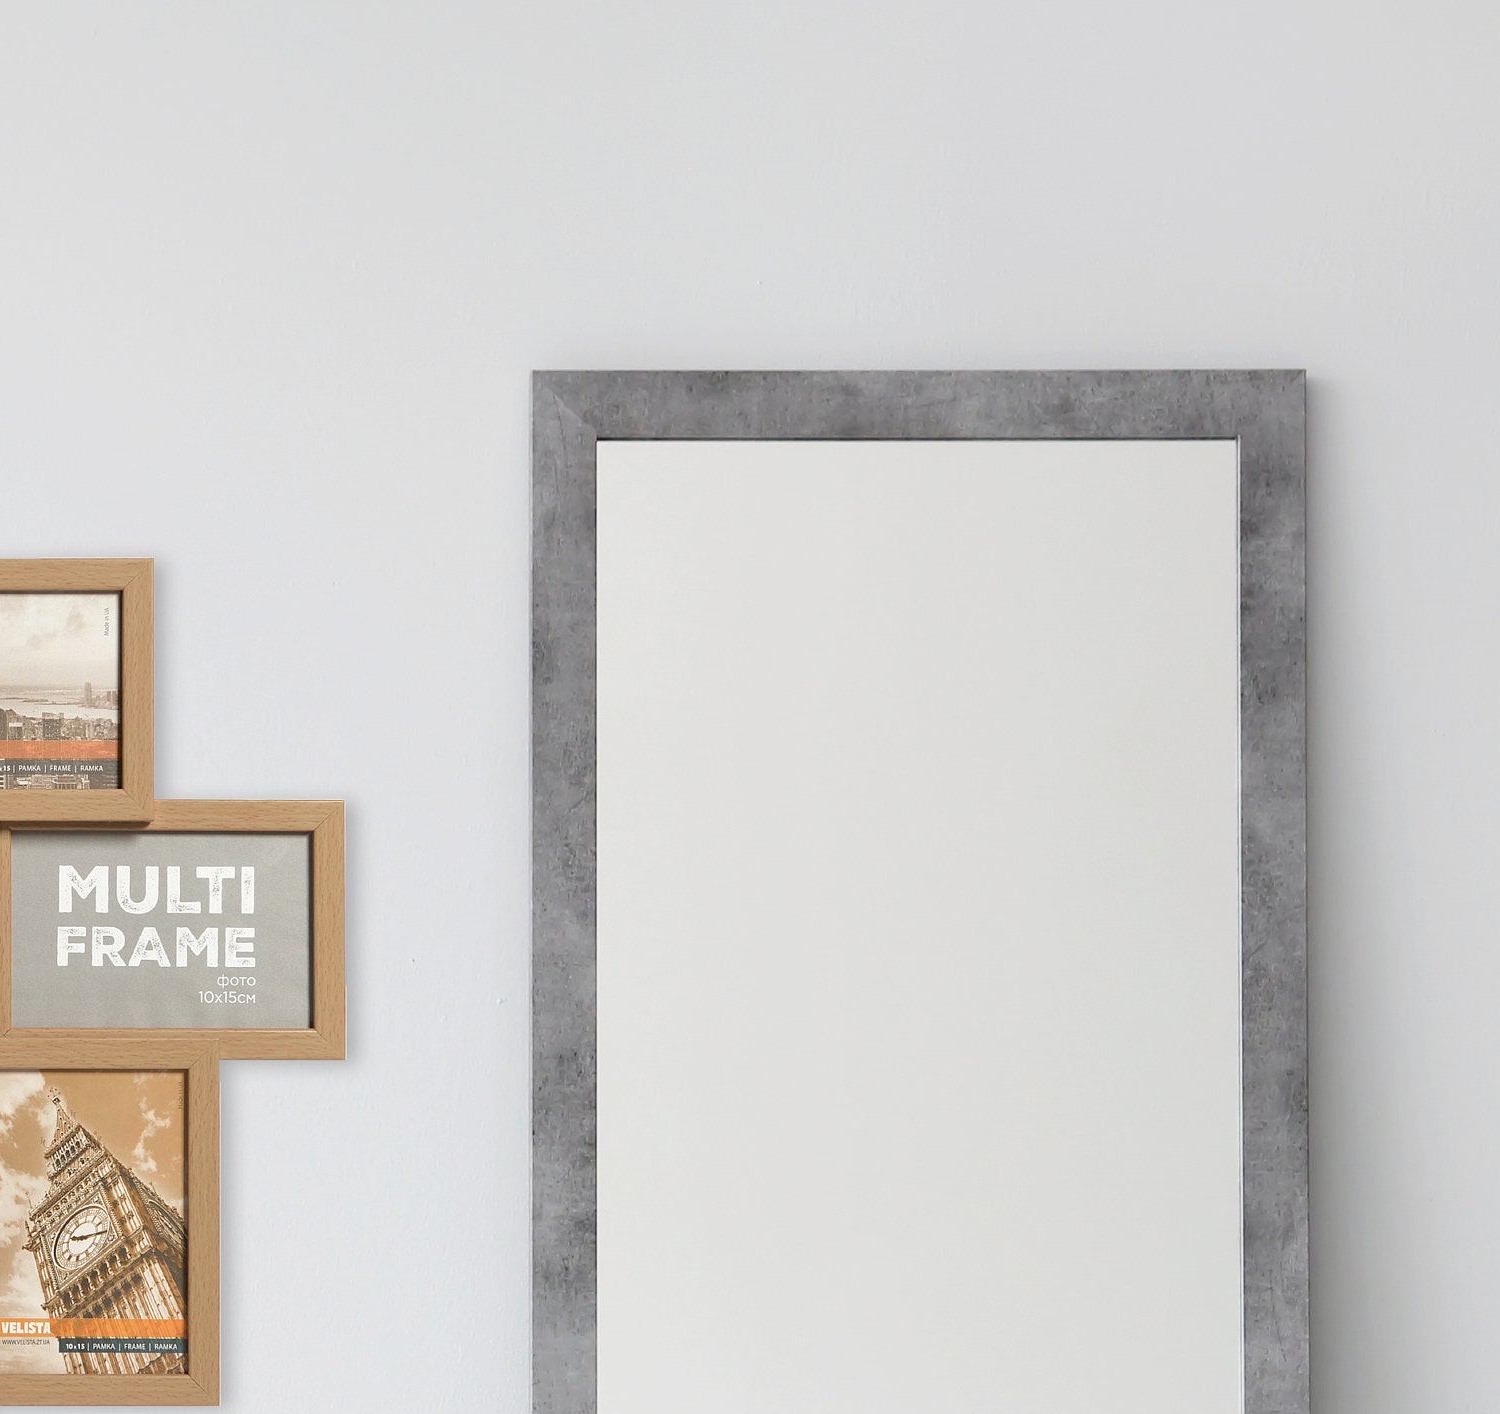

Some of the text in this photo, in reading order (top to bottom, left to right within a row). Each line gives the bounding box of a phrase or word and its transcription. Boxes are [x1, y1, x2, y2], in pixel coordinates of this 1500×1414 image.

[58, 865, 255, 914] MULTI
[57, 926, 256, 968] FRAME
[217, 974, 256, 989] фото
[1, 1321, 51, 1334] VELISTA
